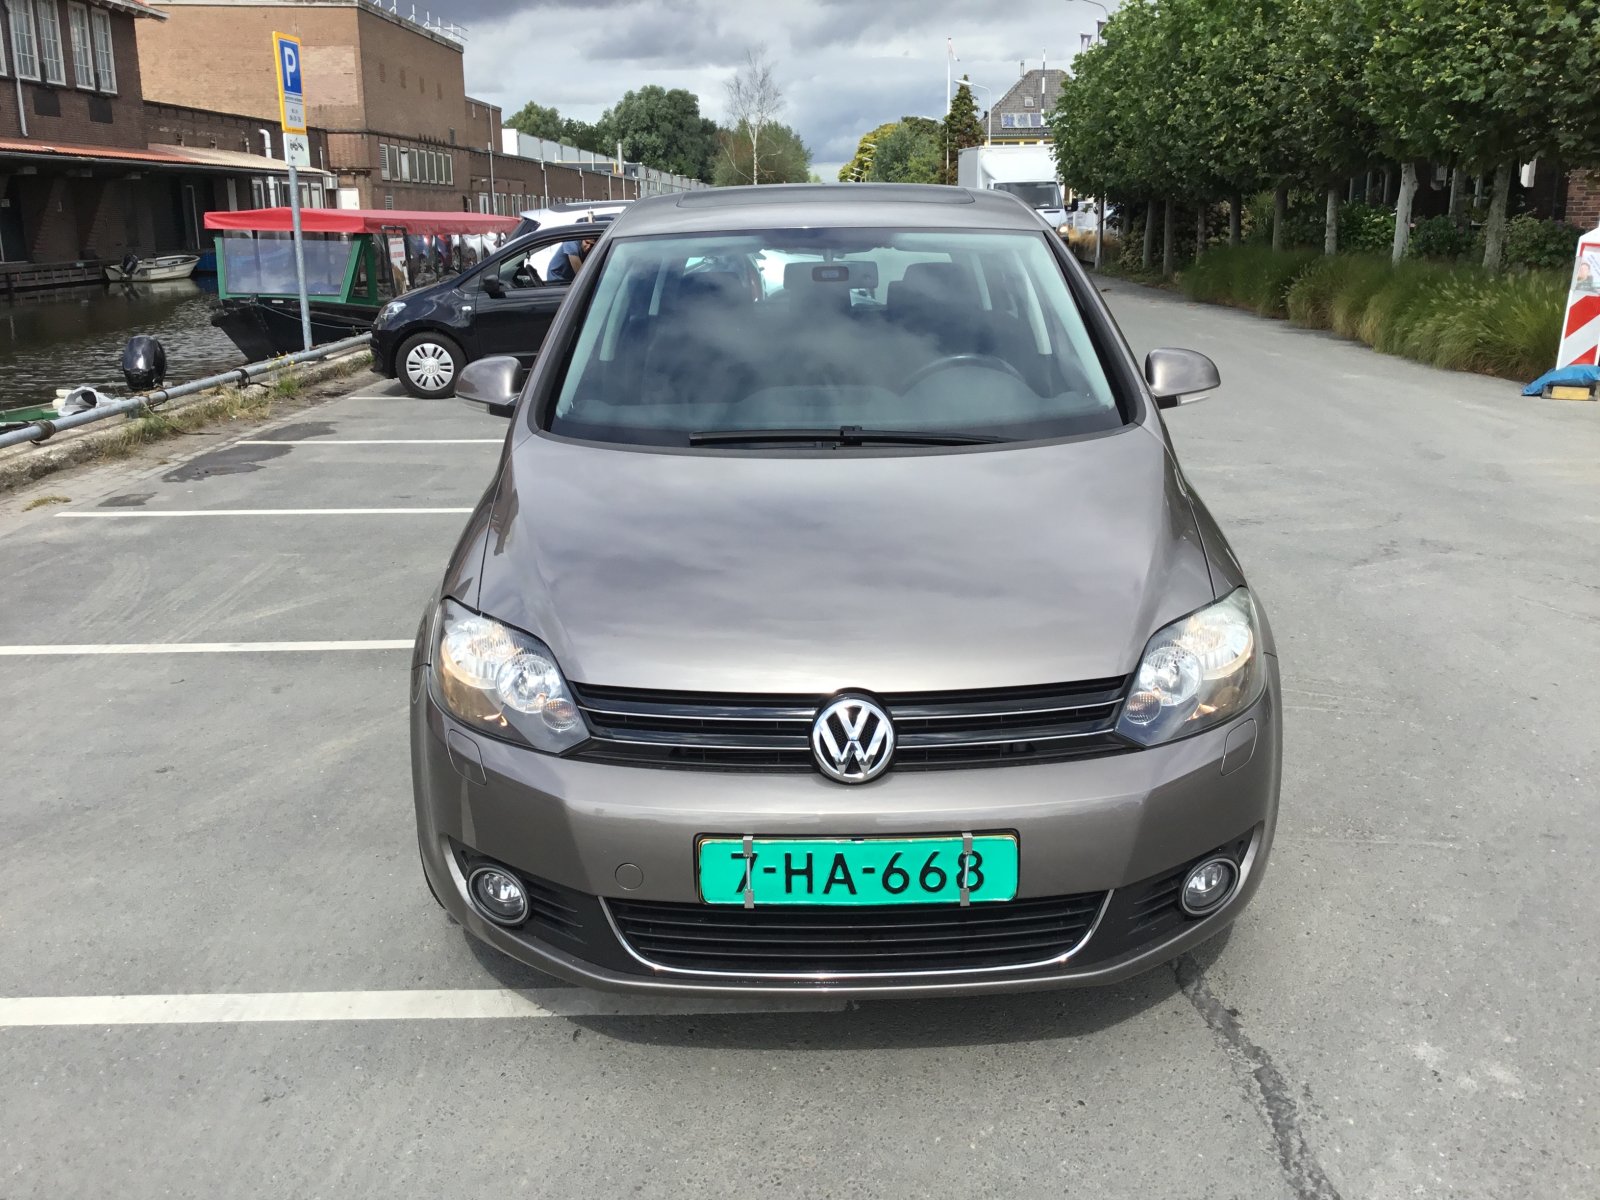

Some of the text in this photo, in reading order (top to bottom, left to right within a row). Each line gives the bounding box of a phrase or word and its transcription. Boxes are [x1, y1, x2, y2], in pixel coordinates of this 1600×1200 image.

[284, 46, 297, 87] P
[813, 699, 894, 783] VW
[730, 850, 985, 895] 7-HA-668
